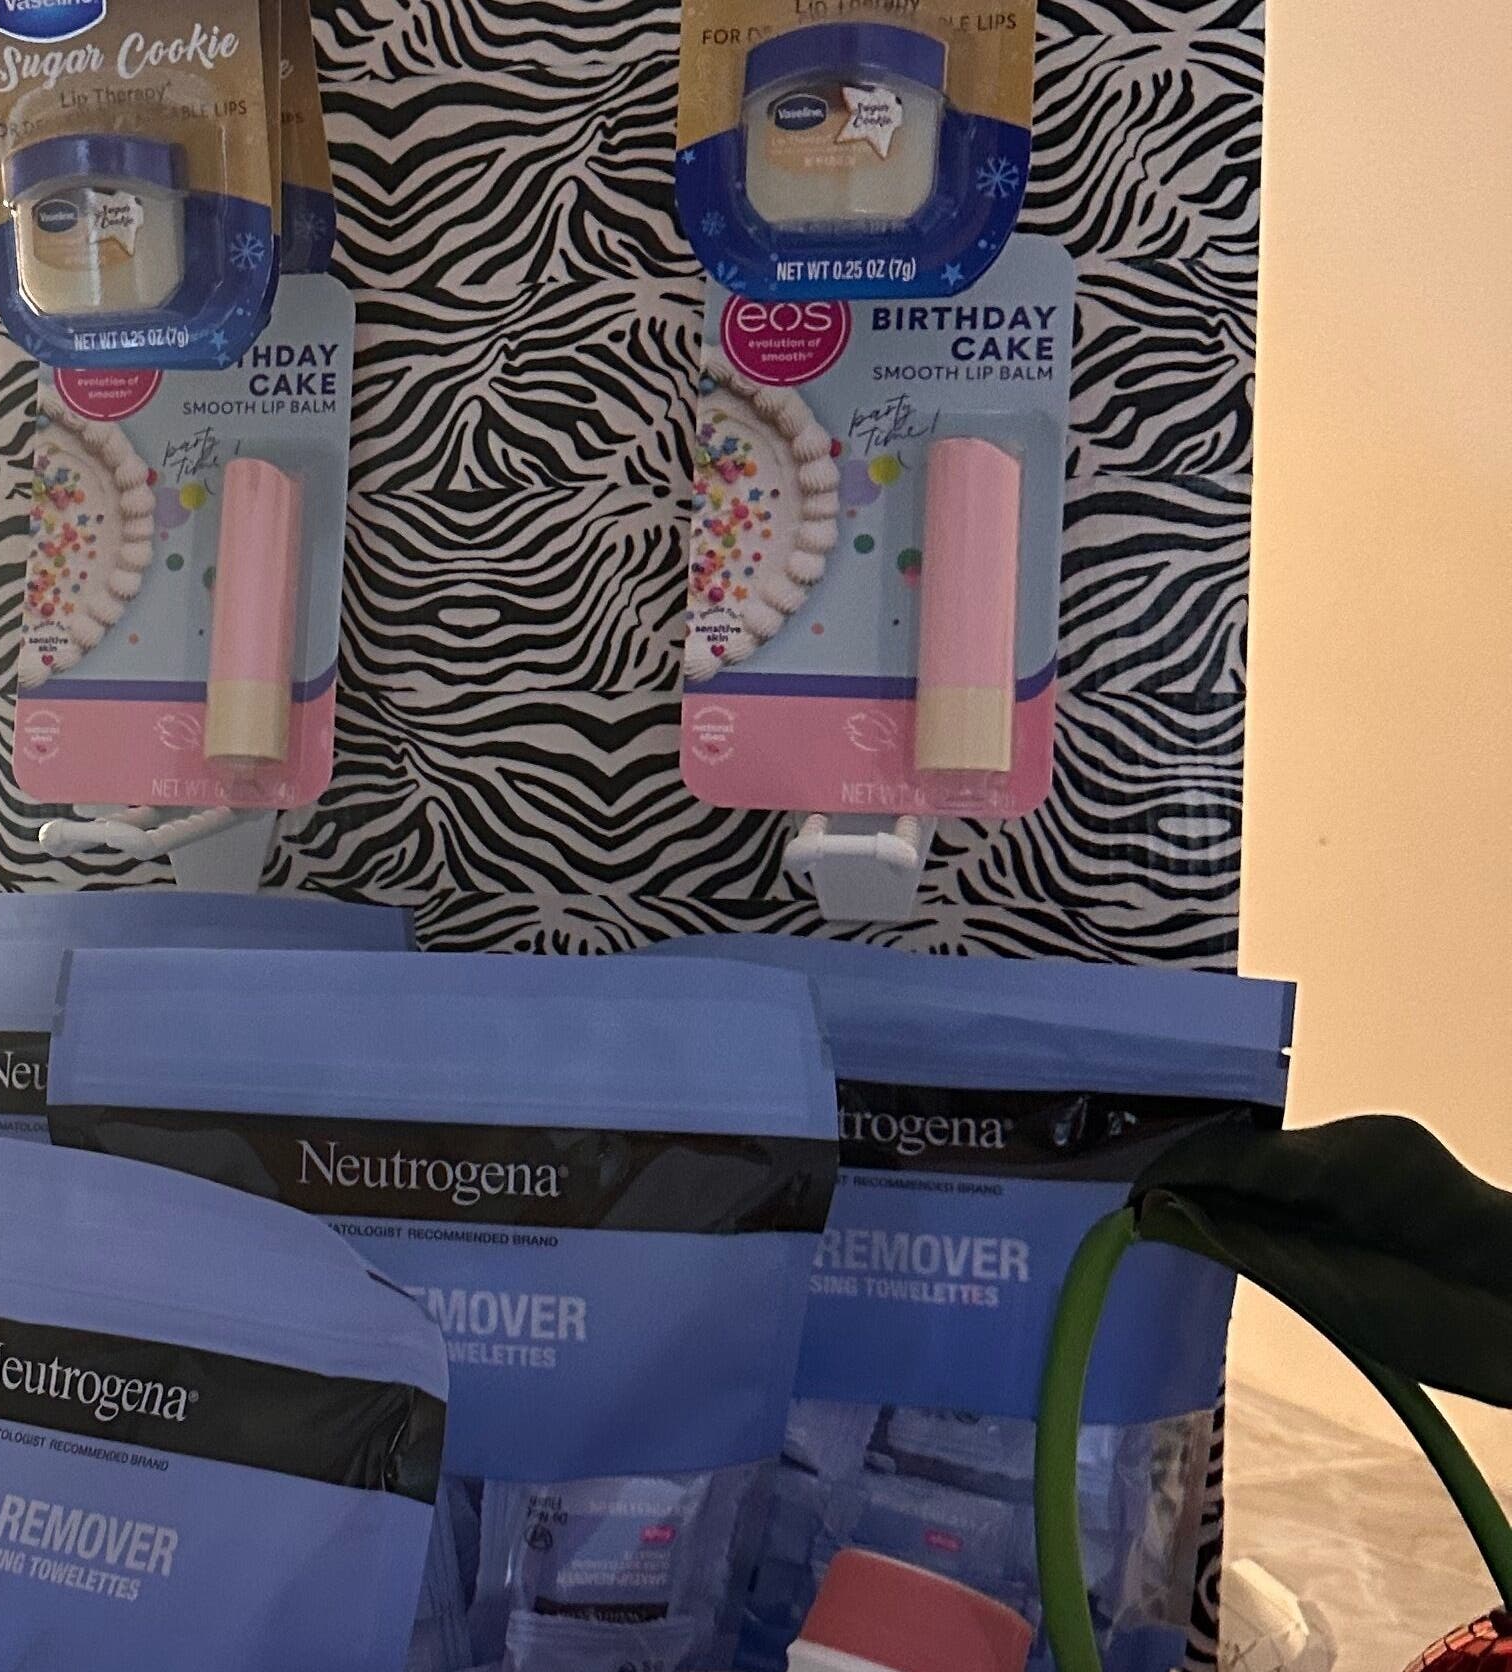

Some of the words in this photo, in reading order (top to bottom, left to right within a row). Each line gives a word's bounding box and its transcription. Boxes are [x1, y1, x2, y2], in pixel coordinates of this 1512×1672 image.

[976, 13, 1017, 32] LIPS
[701, 27, 741, 45] FOR
[117, 22, 239, 80] Cookie
[213, 99, 248, 118] LIPS
[777, 262, 803, 281] NET
[807, 262, 830, 280] WT
[833, 261, 863, 280] 0.25
[867, 260, 886, 278] OZ
[889, 257, 916, 281] (7g)
[736, 302, 833, 333] eos
[872, 305, 1057, 332] BIRTHDAY
[73, 332, 97, 352] NET
[99, 330, 118, 351] WT
[120, 329, 146, 349] 0.25
[148, 328, 165, 347] OZ
[166, 324, 190, 348] (7g)
[747, 338, 806, 349] evolution
[808, 337, 822, 348] of
[950, 336, 1054, 362] CAKE
[872, 366, 959, 382] SMOOTH
[965, 365, 993, 381] LIP
[1000, 365, 1054, 381] BALM
[248, 372, 337, 397] CAKE
[183, 401, 256, 416] SMOOTH
[262, 401, 286, 415] LIP
[290, 400, 337, 414] BALM
[695, 625, 741, 634] sensitive
[706, 633, 729, 643] skin
[28, 636, 69, 645] sensitive
[152, 778, 178, 798] NET
[841, 783, 874, 805] NET
[853, 1175, 955, 1194] RECOMMENDED
[407, 1227, 509, 1246] RECOMMENDED
[512, 1233, 559, 1248] BRAND
[811, 1228, 1030, 1283] REMOVER
[865, 1278, 1000, 1307] TOWELETTES
[48, 1437, 129, 1465] RECOMMENDED
[130, 1453, 169, 1472] BRAND
[28, 1555, 142, 1602] TOWELETTES
